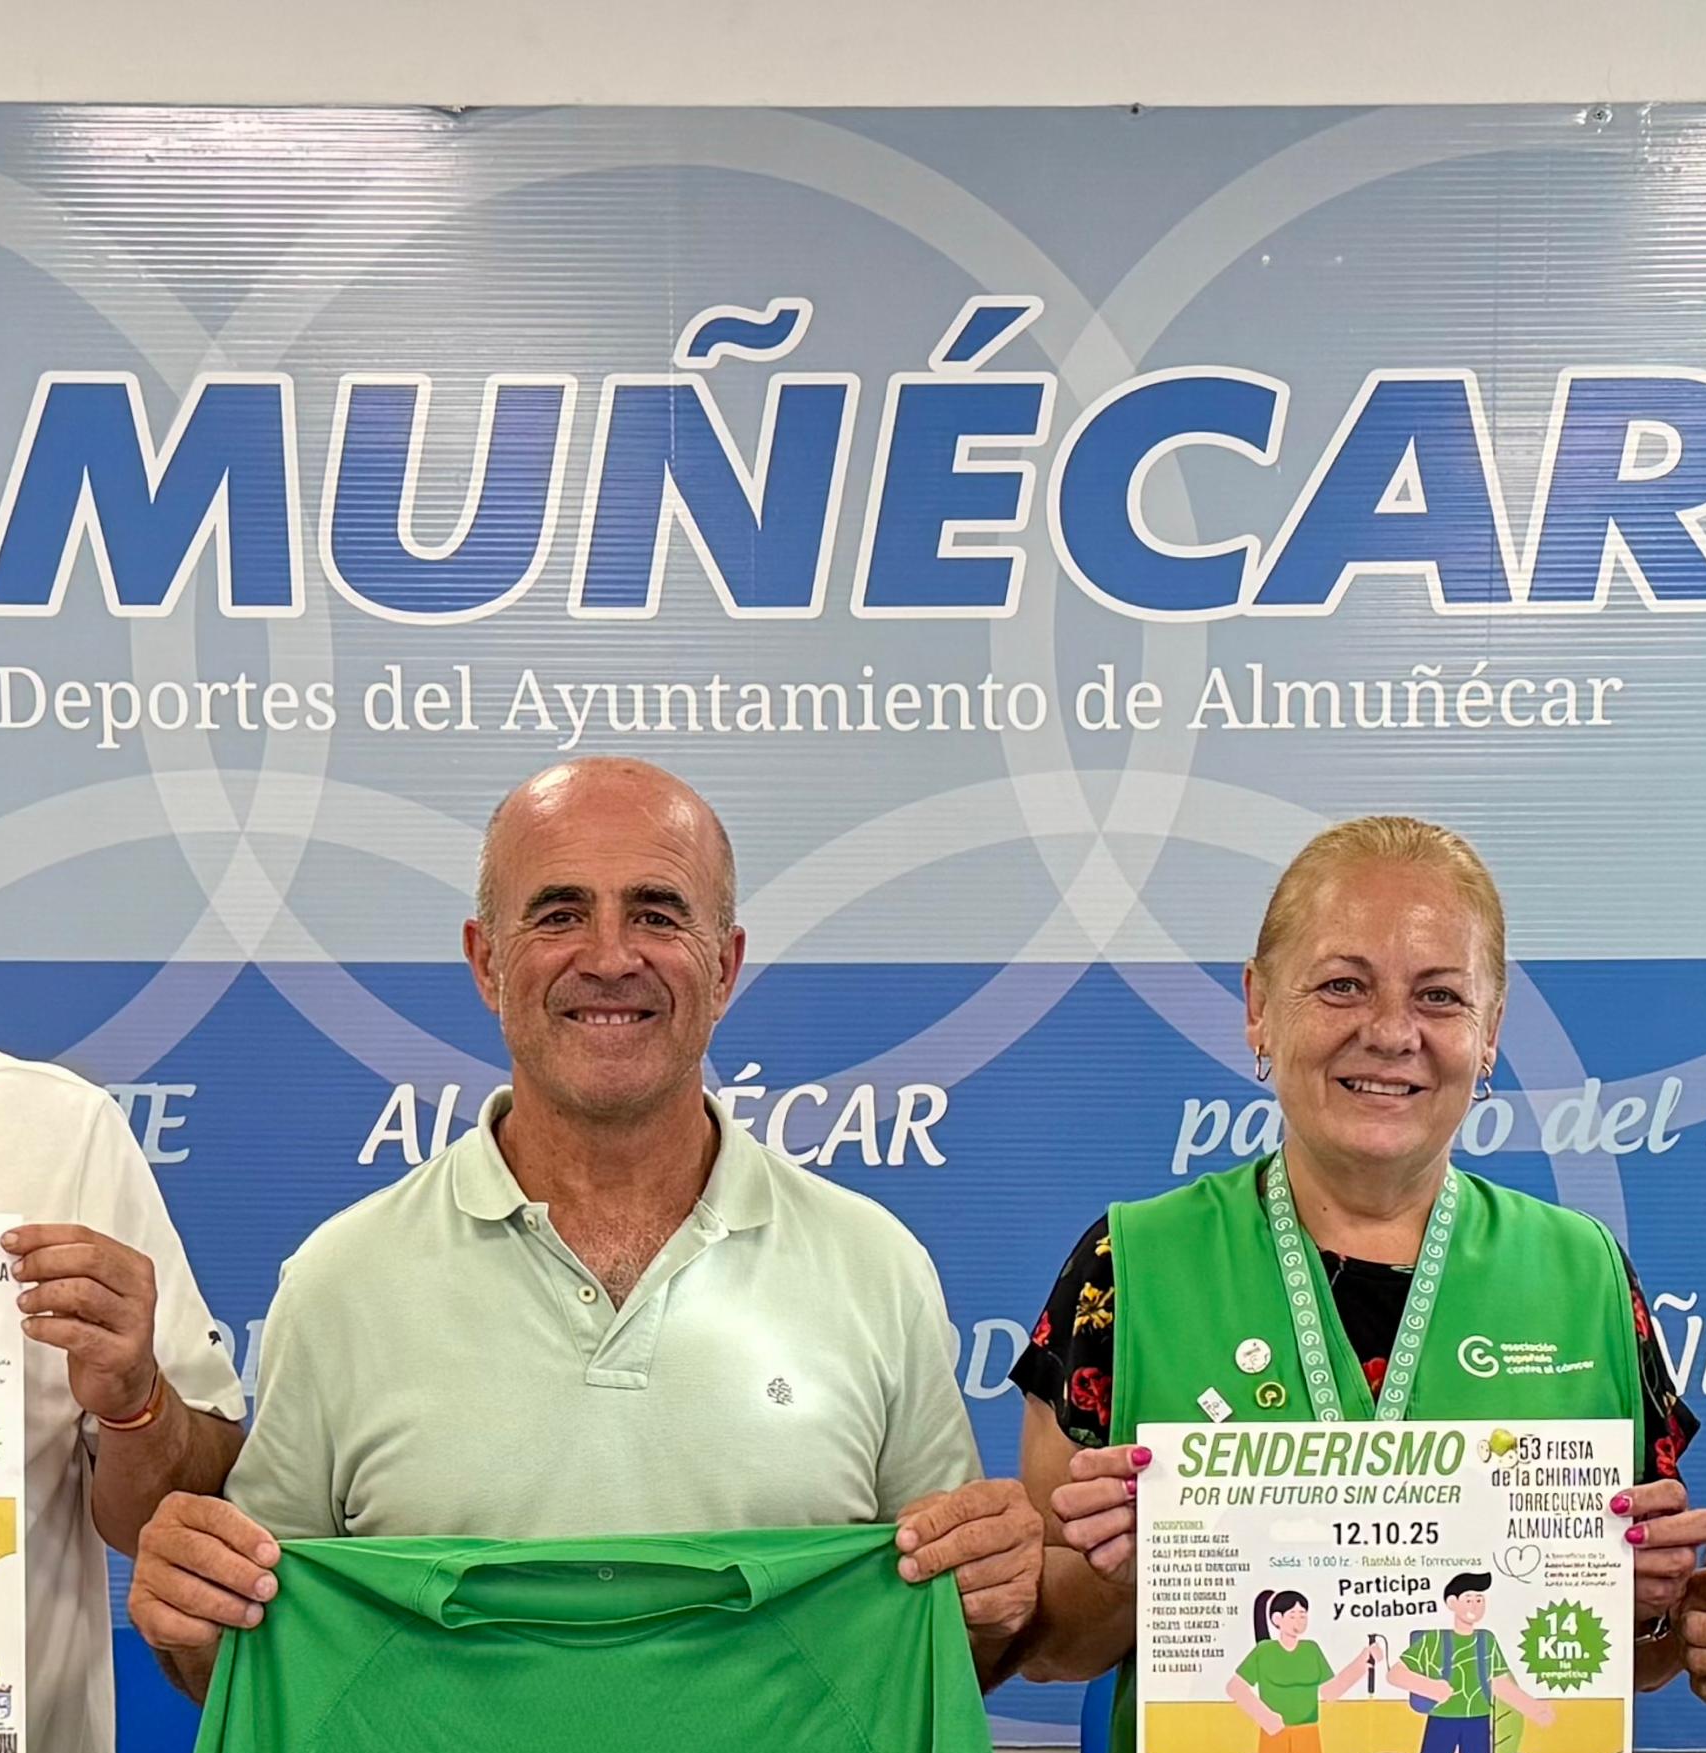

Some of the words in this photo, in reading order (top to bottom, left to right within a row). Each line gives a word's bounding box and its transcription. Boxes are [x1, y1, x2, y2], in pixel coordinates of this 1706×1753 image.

[364, 665, 479, 731] del
[504, 667, 1047, 749] Ayuntamiento
[1075, 665, 1163, 731] de
[1190, 657, 1624, 731] Almuñécar
[357, 1062, 949, 1167] ALÉCAR
[1543, 1077, 1680, 1156] del
[1178, 1431, 1465, 1477] SENDERISMO
[1520, 1437, 1541, 1460] 53
[1548, 1441, 1593, 1460] FIESTA
[1492, 1469, 1510, 1486] de
[1516, 1468, 1530, 1486] la
[1536, 1467, 1620, 1486] CHIRIMOYA
[1180, 1487, 1220, 1506] POR
[1227, 1487, 1253, 1505] UN
[1260, 1486, 1338, 1505] FUTURO
[1344, 1486, 1376, 1504] SIN
[1383, 1481, 1461, 1504] CÁNCER
[1510, 1492, 1602, 1512] TORRECUEVAS
[1333, 1522, 1438, 1545] 12.10.25
[1507, 1513, 1603, 1539] ALMUÑÉCAR
[1362, 1556, 1402, 1567] Rambla
[1405, 1557, 1416, 1567] de
[1421, 1556, 1482, 1567] Torrecuevas
[1339, 1575, 1430, 1596] Participa
[1334, 1602, 1345, 1620] y
[1351, 1599, 1437, 1617] colabora
[1545, 1613, 1577, 1635] 14
[1538, 1637, 1589, 1660] Km.
